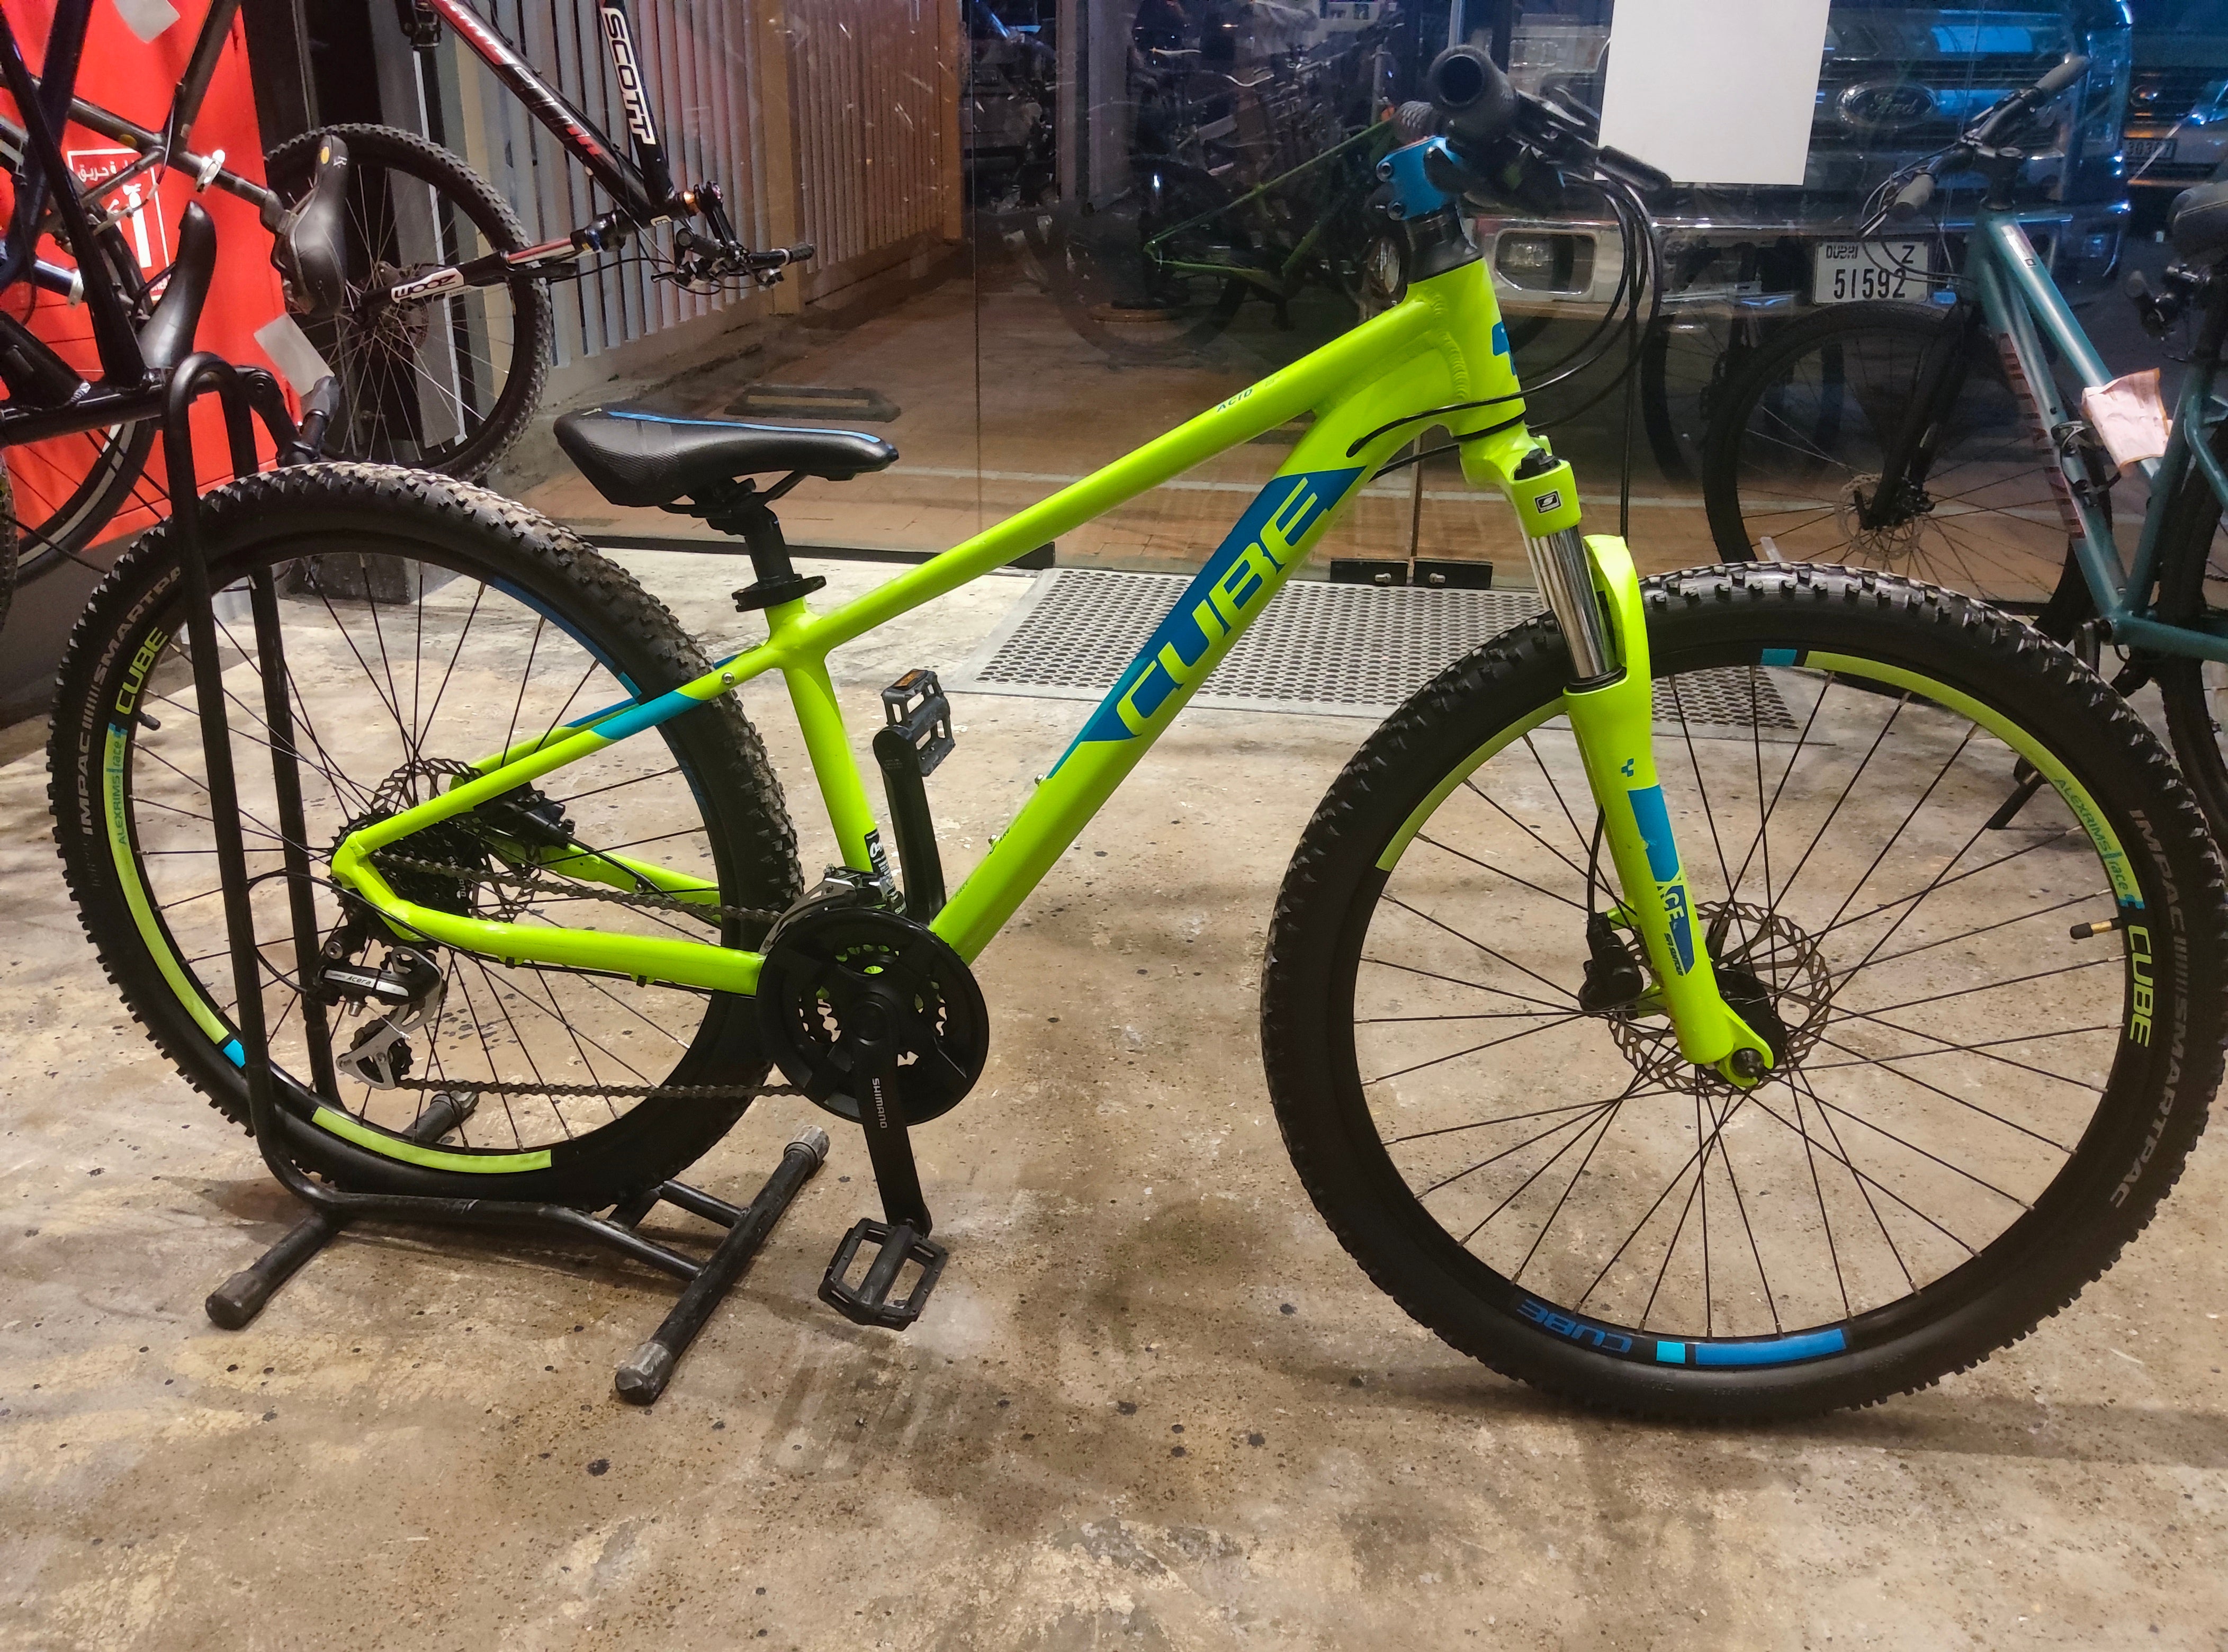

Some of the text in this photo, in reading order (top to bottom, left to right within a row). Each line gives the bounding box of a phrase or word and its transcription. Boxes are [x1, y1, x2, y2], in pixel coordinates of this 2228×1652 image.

[604, 12, 655, 142] SCOTT
[78, 164, 110, 183] حريق
[394, 274, 456, 299] ZOOM
[1834, 267, 1906, 300] 51592
[1901, 245, 1915, 264] Z
[1217, 388, 1253, 412] ACID
[1116, 477, 1328, 737] CUBE
[78, 565, 181, 836] IMPAC SMARTPA
[115, 626, 168, 715] CUBE
[111, 741, 128, 846] ALEXRIMS race
[2054, 777, 2128, 890] ALEXRIMS race
[346, 975, 372, 985] Acera
[2109, 809, 2188, 1208] IMPAC SMARTPAC
[2127, 924, 2154, 1048] CUBE
[872, 1078, 888, 1129] SHIMANO
[1516, 1299, 1633, 1353] CUBE
